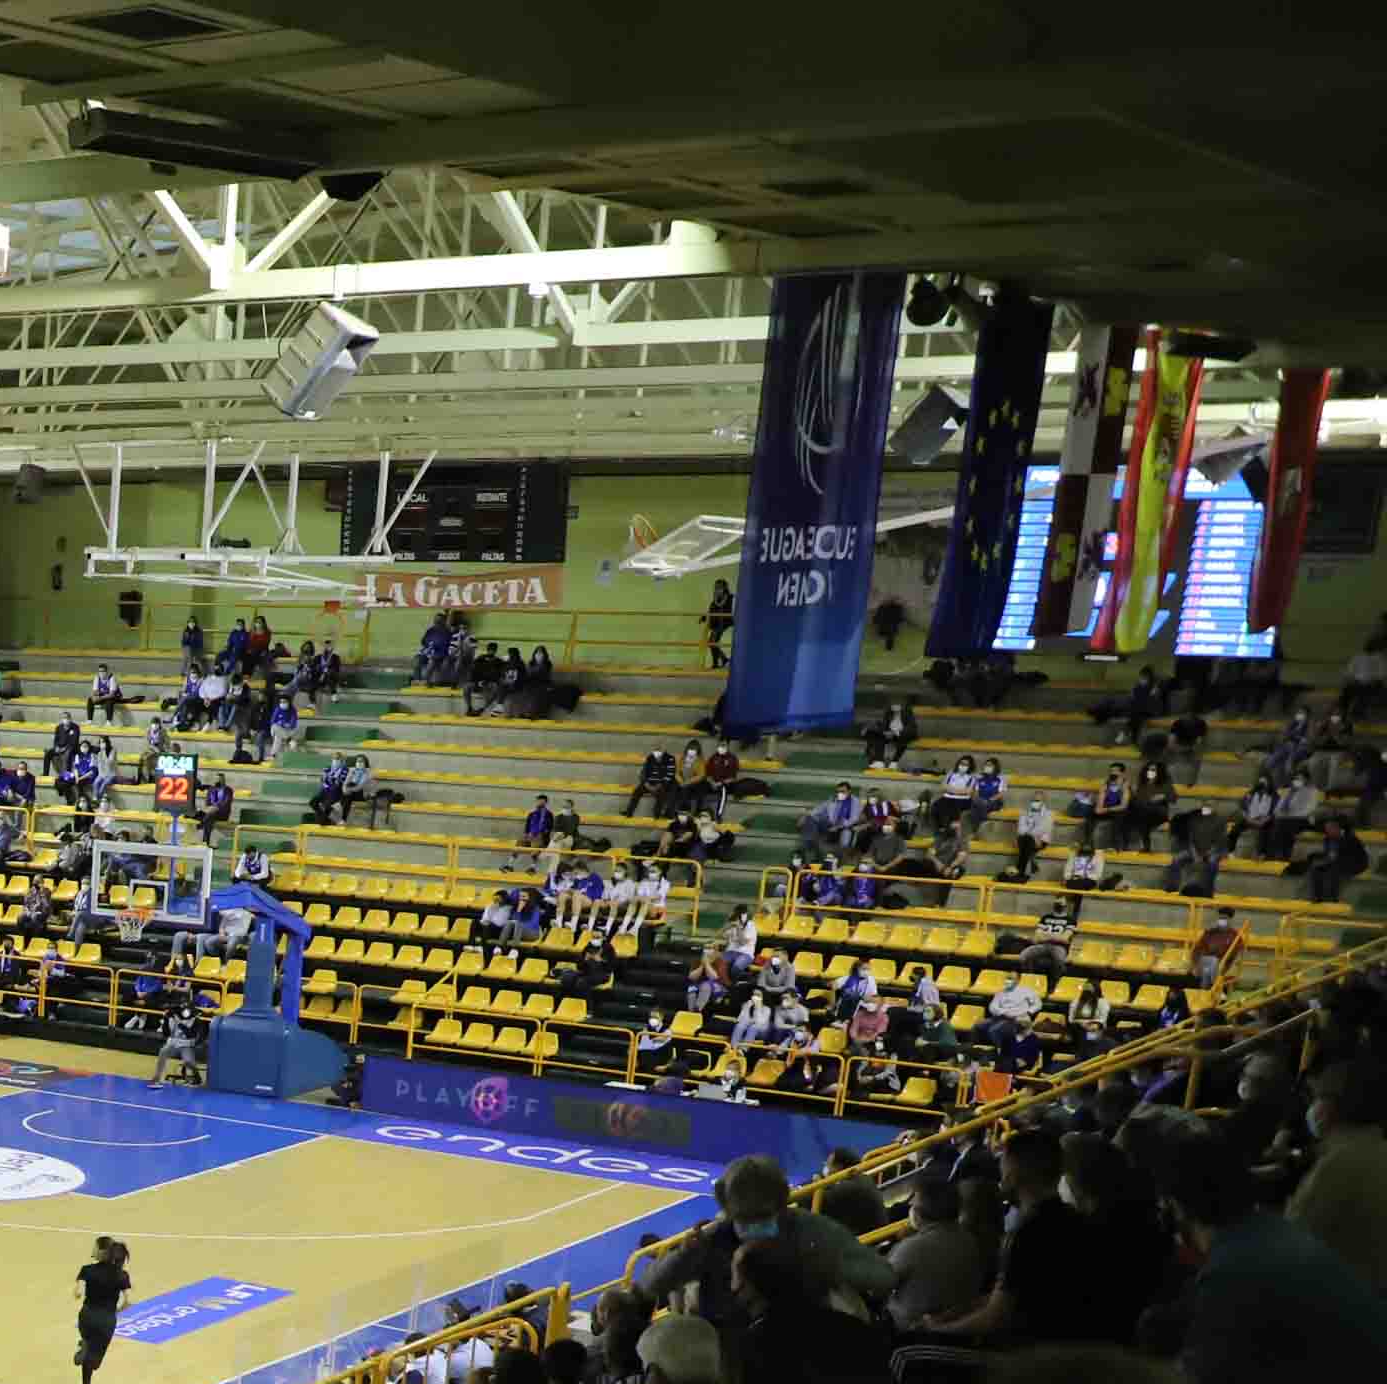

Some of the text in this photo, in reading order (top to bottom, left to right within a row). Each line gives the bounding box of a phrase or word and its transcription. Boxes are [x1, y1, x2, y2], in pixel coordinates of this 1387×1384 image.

[397, 492, 429, 503] LCAL
[414, 575, 548, 607] GACETA
[158, 777, 188, 800] 22
[376, 1124, 717, 1185] endes
